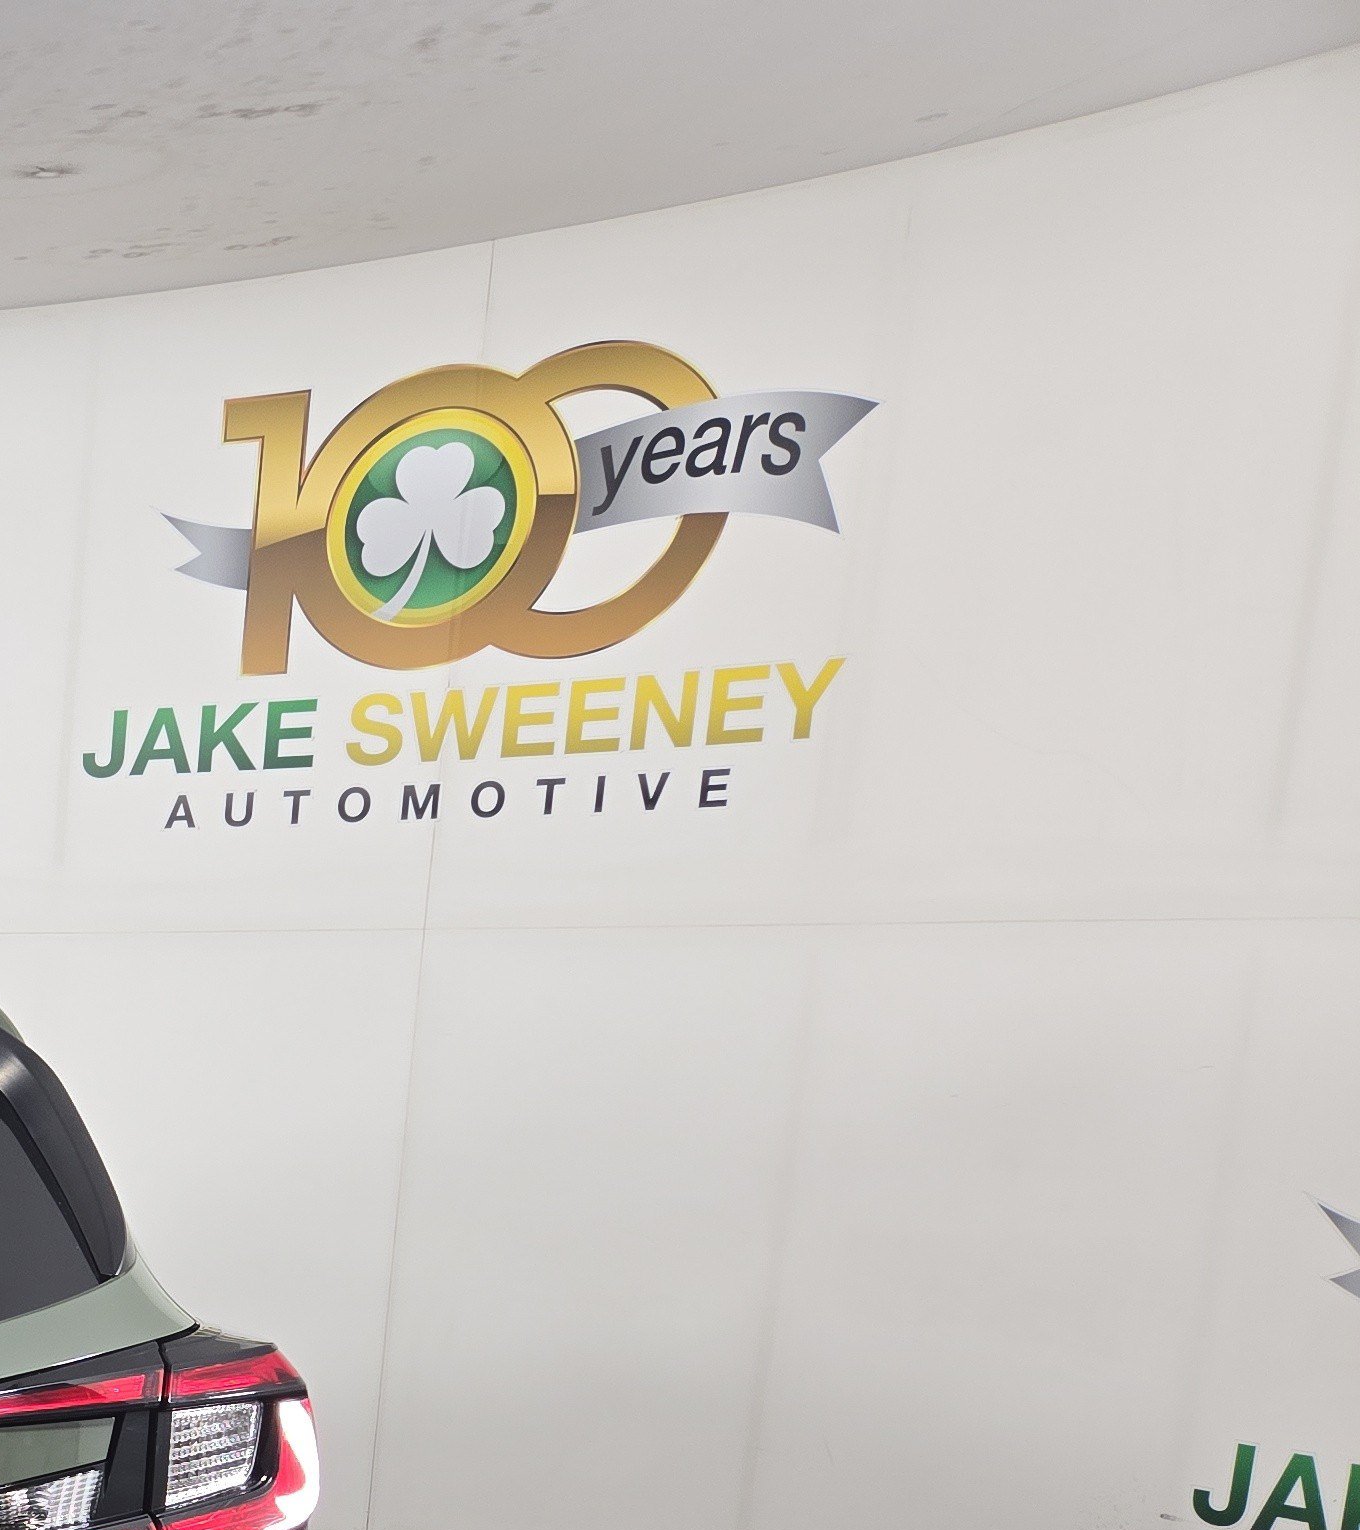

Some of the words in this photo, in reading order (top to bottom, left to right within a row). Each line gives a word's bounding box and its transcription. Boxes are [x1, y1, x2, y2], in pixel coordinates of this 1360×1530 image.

[223, 340, 729, 677] 100
[591, 410, 807, 517] years
[82, 698, 319, 780] JAKE
[345, 658, 847, 768] SWEENEY
[164, 768, 733, 831] AUTOMOTIVE
